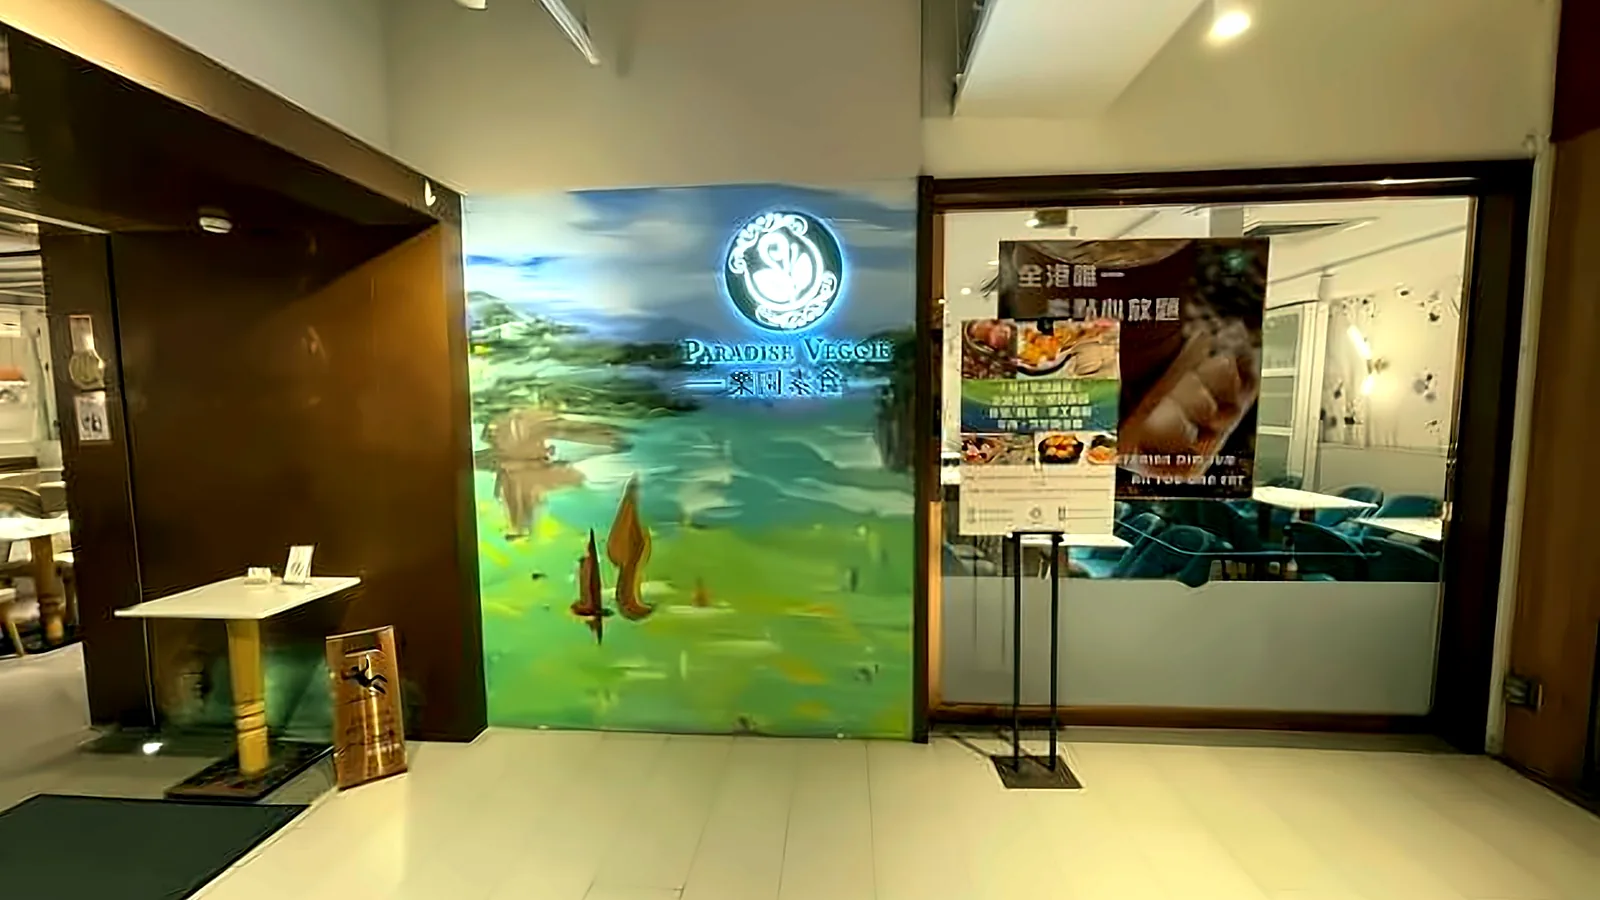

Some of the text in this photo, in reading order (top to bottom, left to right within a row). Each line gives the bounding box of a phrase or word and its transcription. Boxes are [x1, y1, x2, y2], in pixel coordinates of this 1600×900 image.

[1018, 263, 1125, 288] 全港唯一
[683, 339, 795, 364] PARADISE
